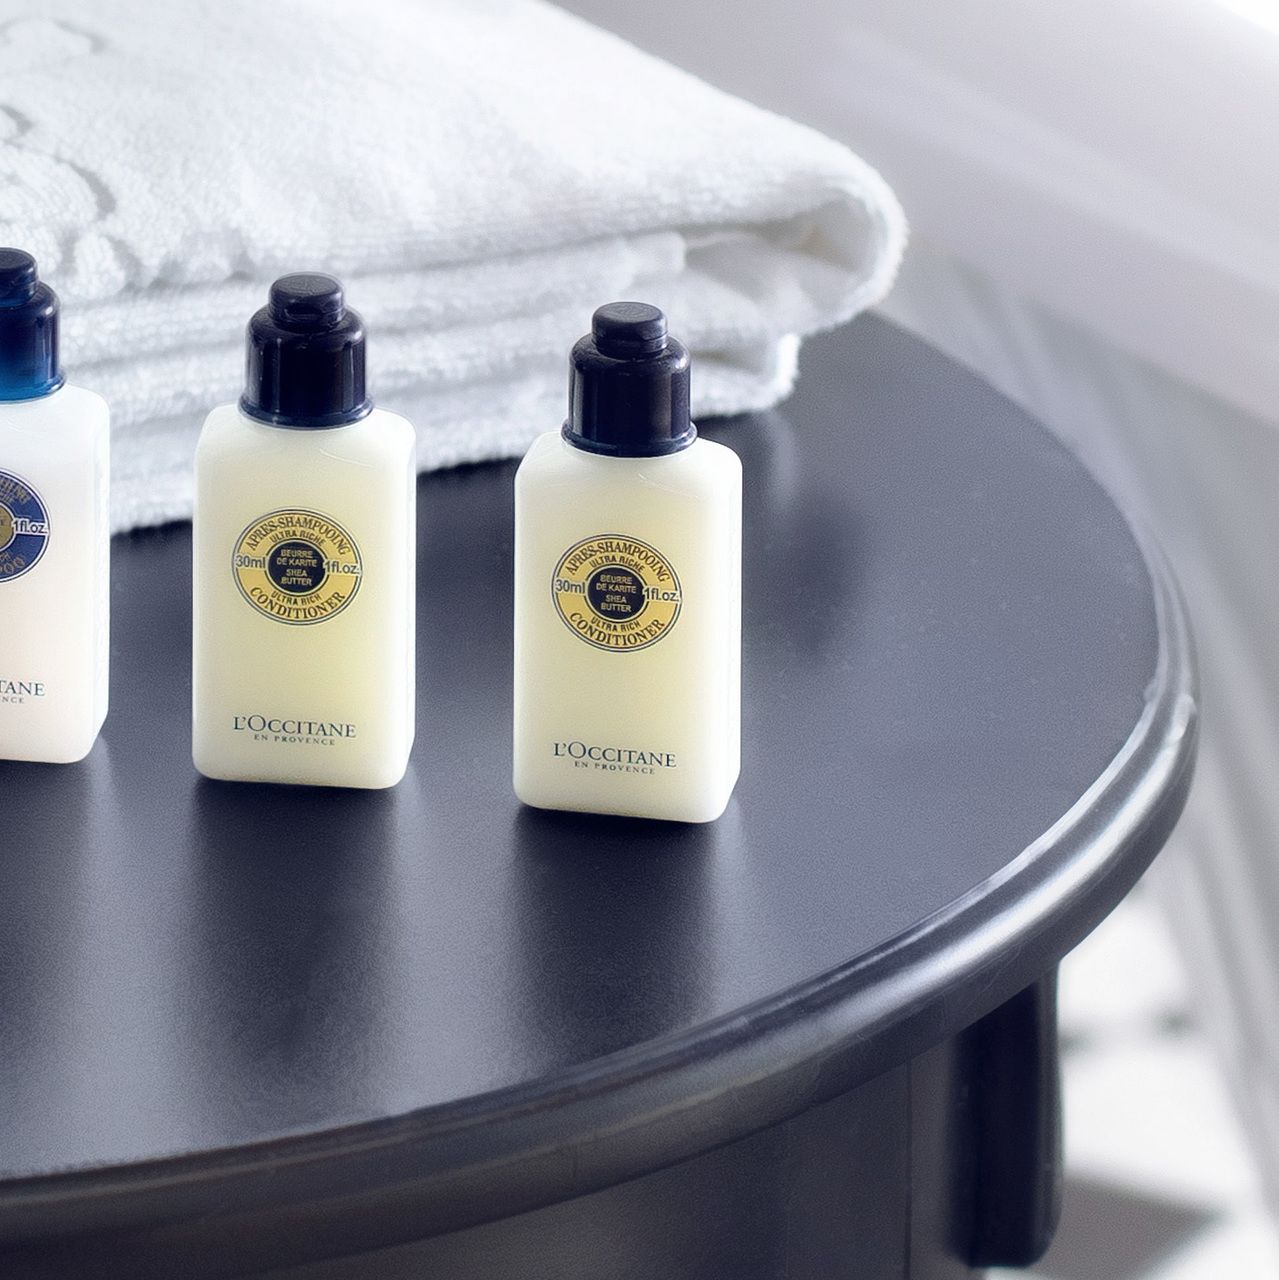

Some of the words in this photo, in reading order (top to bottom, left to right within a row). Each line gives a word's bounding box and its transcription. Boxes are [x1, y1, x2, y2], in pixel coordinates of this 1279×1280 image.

[269, 529, 298, 544] ULTRA
[300, 529, 326, 546] RICHE
[281, 549, 313, 558] BEURRE
[235, 555, 266, 569] 30ml
[276, 558, 288, 566] DE
[588, 554, 617, 569] ULTRA
[619, 556, 646, 573] RICHE
[286, 568, 308, 577] SHEA
[600, 574, 633, 584] BEURRE
[281, 577, 313, 586] BUTTER
[555, 579, 586, 594] 30ml
[596, 583, 608, 592] DE
[250, 586, 346, 619] CONDITIONER
[271, 590, 299, 605] ULTRA
[300, 593, 322, 606] RICH
[605, 594, 627, 604] SHEA
[600, 603, 632, 613] BUTTER
[570, 612, 665, 646] CONDITIONER
[591, 616, 618, 632] ULTRA
[620, 620, 642, 633] RICH
[254, 733, 268, 741] EN
[274, 735, 335, 746] PROVENCE
[574, 760, 589, 768] EN
[595, 761, 656, 775] PROVENCE
